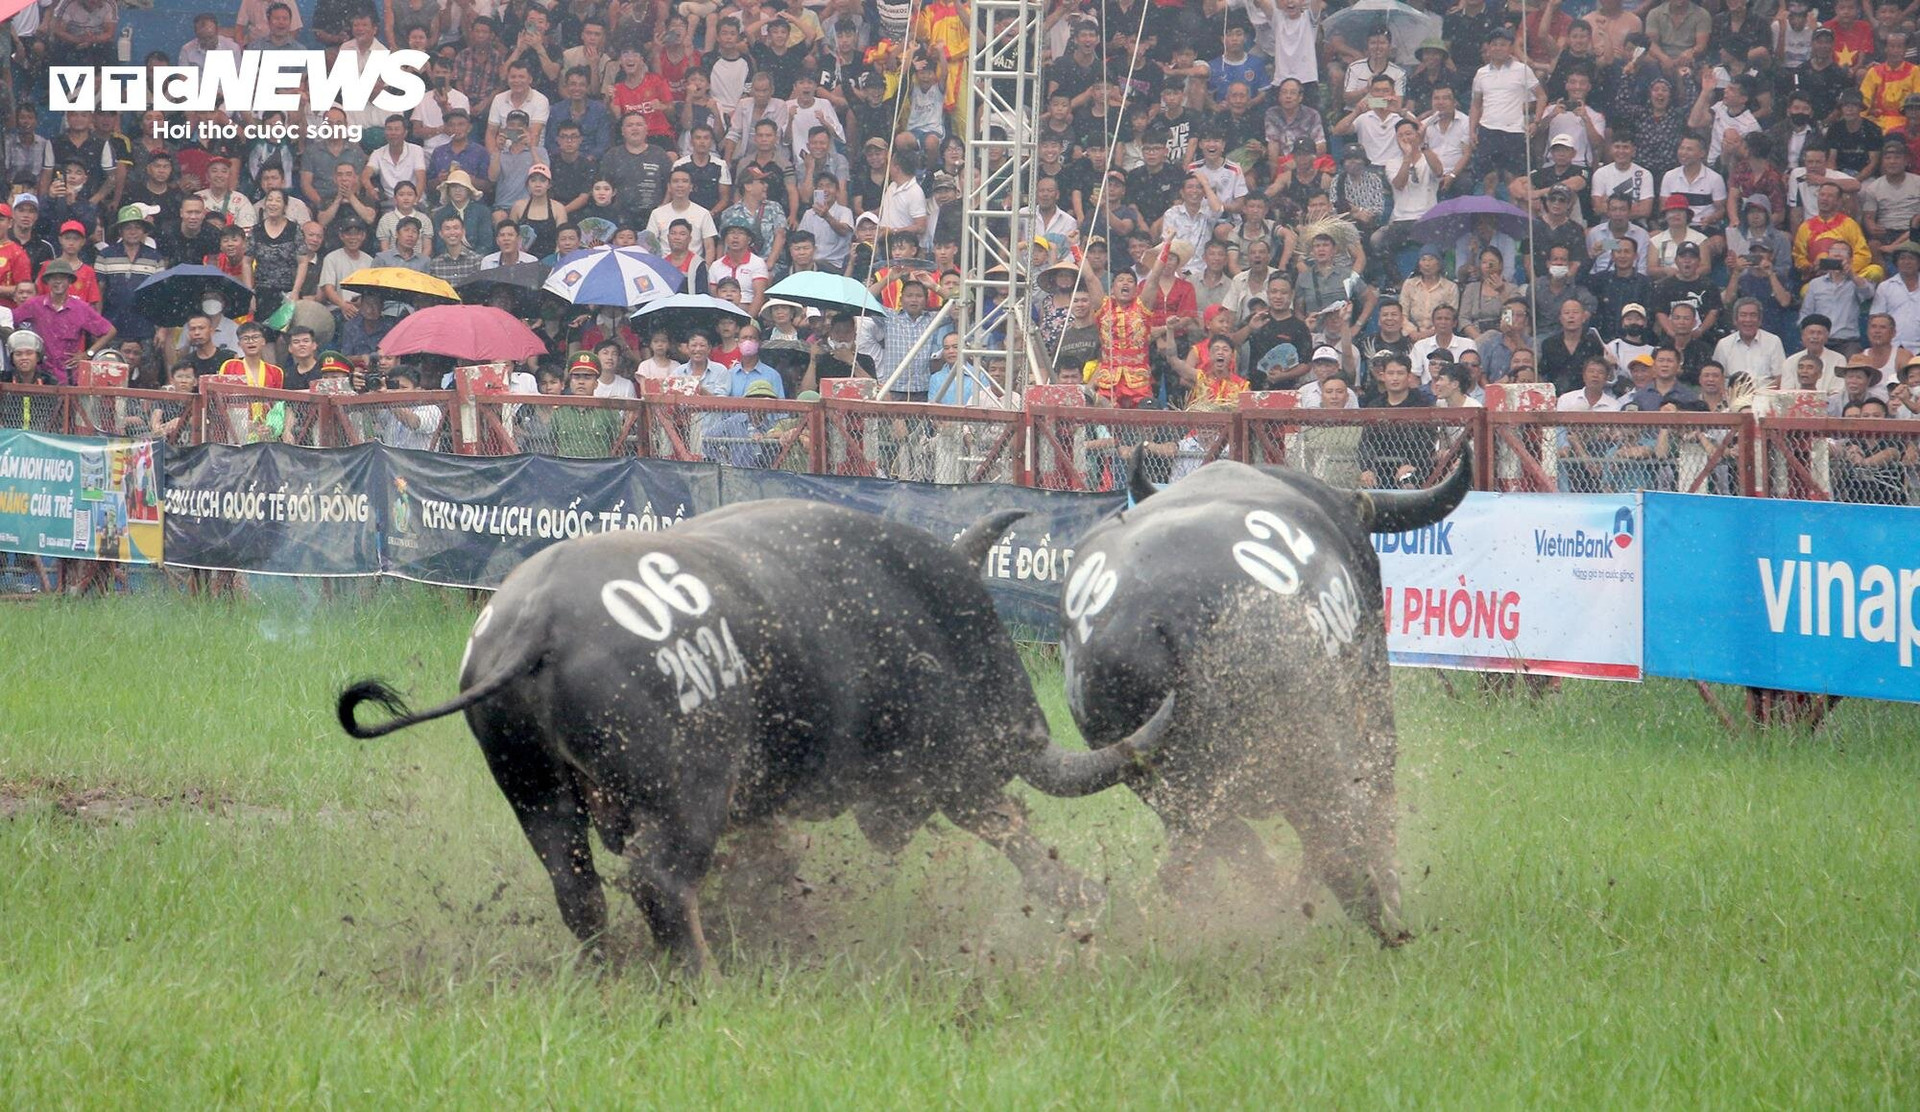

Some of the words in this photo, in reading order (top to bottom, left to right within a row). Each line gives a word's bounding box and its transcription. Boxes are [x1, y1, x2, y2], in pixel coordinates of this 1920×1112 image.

[20, 457, 43, 480] NON
[43, 458, 74, 483] HUGO
[30, 487, 52, 517] CỦA
[54, 489, 74, 519] TRẺ
[190, 490, 220, 524] LỊCH
[223, 480, 265, 521] QUỐC
[268, 481, 288, 521] TẾ
[287, 482, 316, 522] ĐỒI
[319, 482, 369, 523] RỒNG
[421, 499, 457, 530] KHU
[460, 504, 488, 534] DU
[489, 506, 532, 543] LỊCH
[536, 496, 594, 540] QUỐC
[986, 531, 1016, 579] TẾ
[1016, 532, 1058, 582] ĐỒI
[1232, 510, 1316, 596] 02
[1535, 529, 1614, 559] VietinBank
[601, 551, 712, 642] 06
[1402, 574, 1521, 641] PHÒNG
